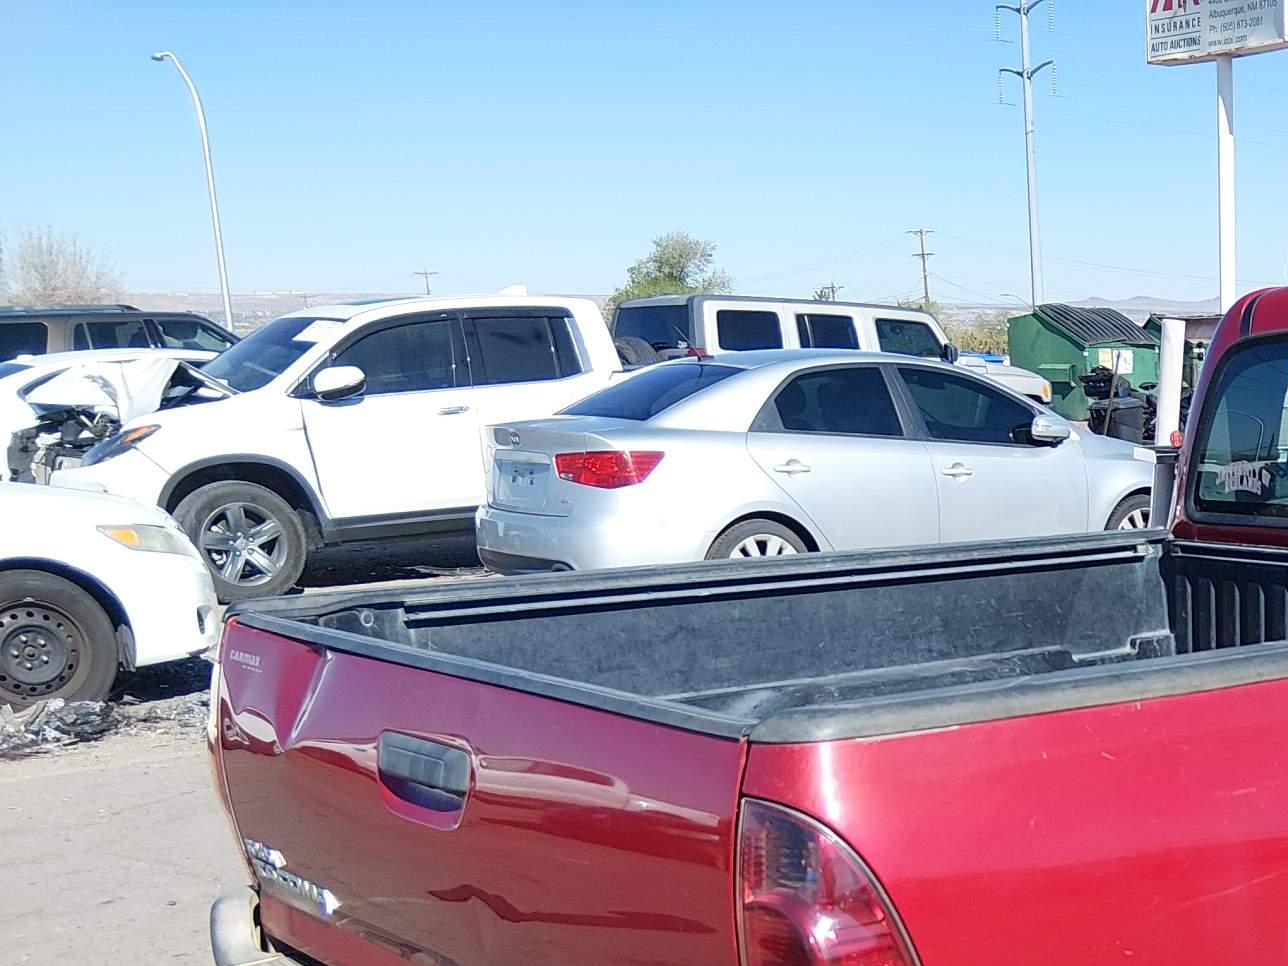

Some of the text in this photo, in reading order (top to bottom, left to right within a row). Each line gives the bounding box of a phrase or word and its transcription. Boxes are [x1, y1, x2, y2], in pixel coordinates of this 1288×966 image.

[1247, 1, 1258, 12] NM
[1150, 16, 1201, 35] INSURANCE
[1151, 35, 1201, 53] AUTO AUCTIONS
